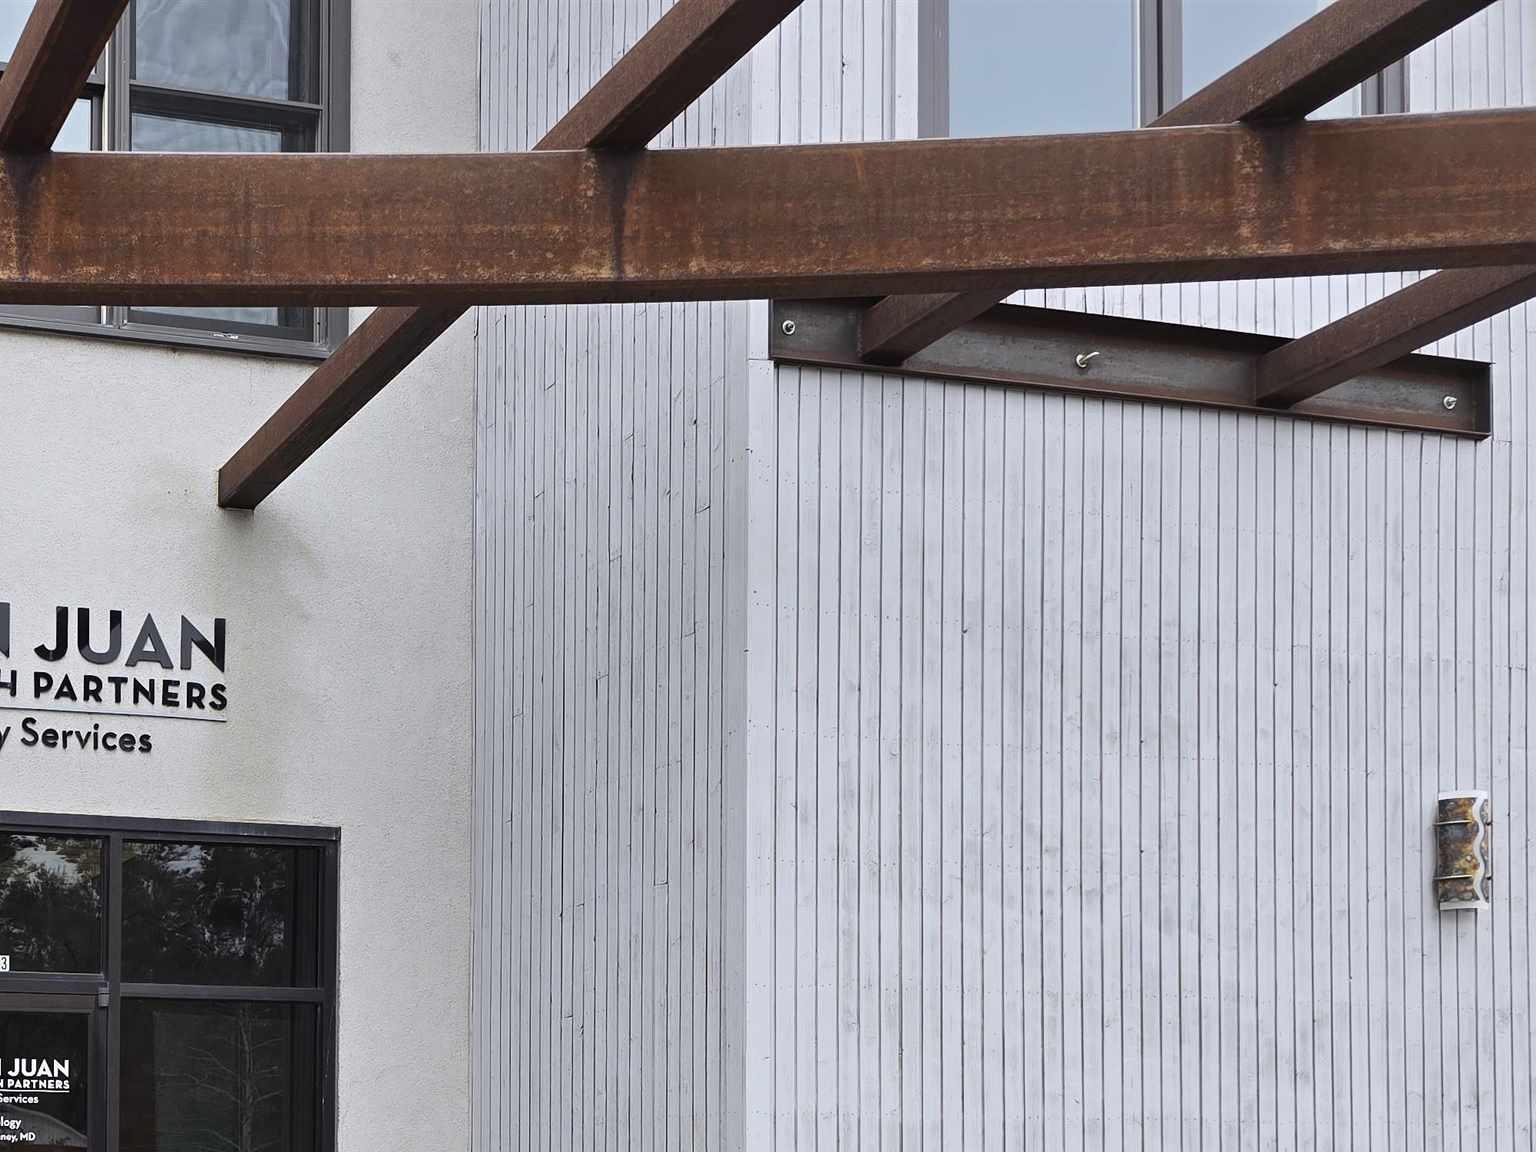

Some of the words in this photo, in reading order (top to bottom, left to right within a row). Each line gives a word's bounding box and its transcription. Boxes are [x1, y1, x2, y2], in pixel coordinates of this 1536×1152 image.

[33, 605, 227, 673] JUAN
[33, 671, 228, 712] PARTNERS
[20, 716, 153, 754] Services
[7, 1058, 70, 1078] JUAN
[7, 1078, 70, 1090] PARTNERS
[20, 1132, 36, 1141] MD
